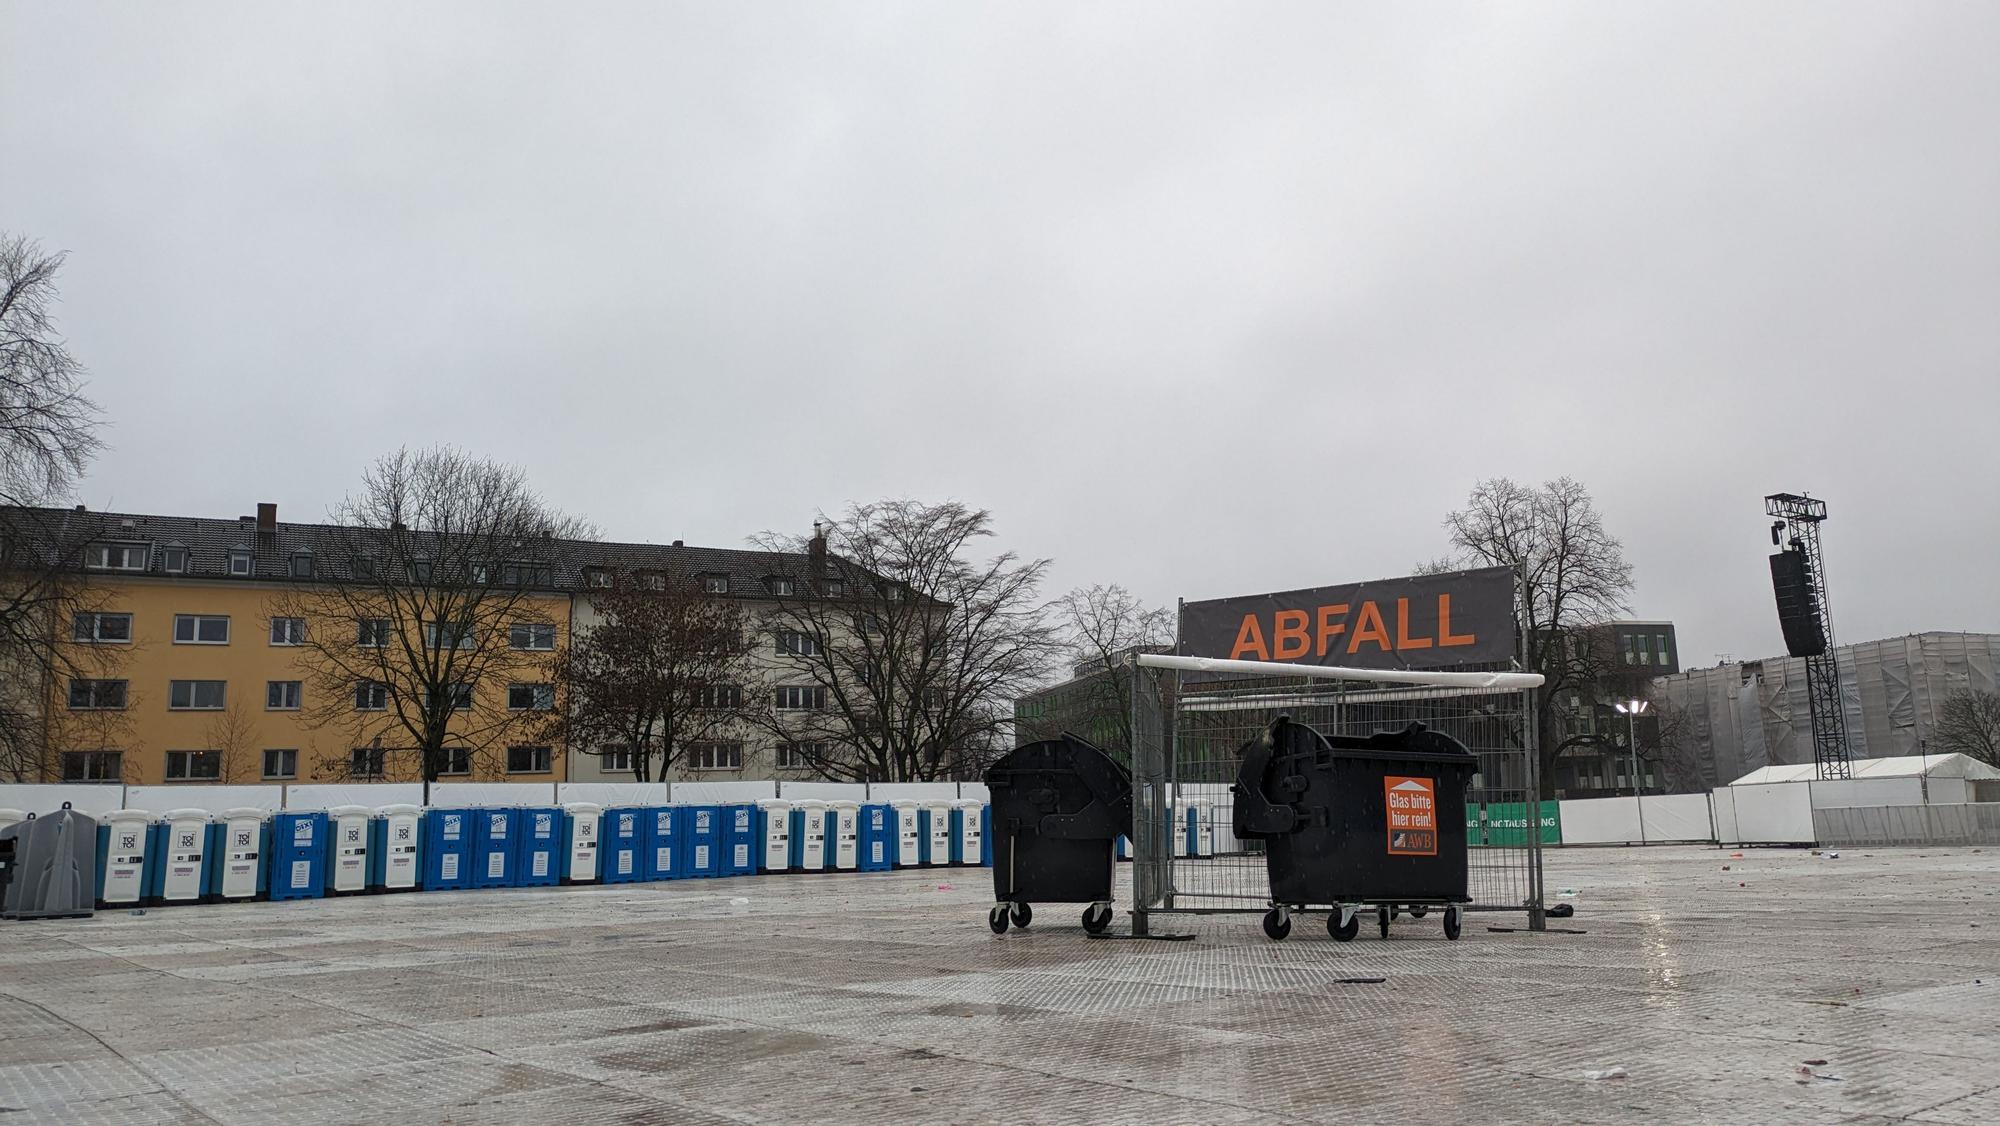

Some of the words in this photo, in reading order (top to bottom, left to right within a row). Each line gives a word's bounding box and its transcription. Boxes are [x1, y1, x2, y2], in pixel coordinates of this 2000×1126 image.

[1230, 593, 1476, 661] ABFALL
[1389, 792, 1409, 809] Glas
[1410, 793, 1432, 810] bitte
[1391, 810, 1409, 826] hier
[1411, 811, 1432, 827] rein!
[1490, 817, 1556, 828] NOTAUSNG
[1407, 833, 1432, 849] AWB
